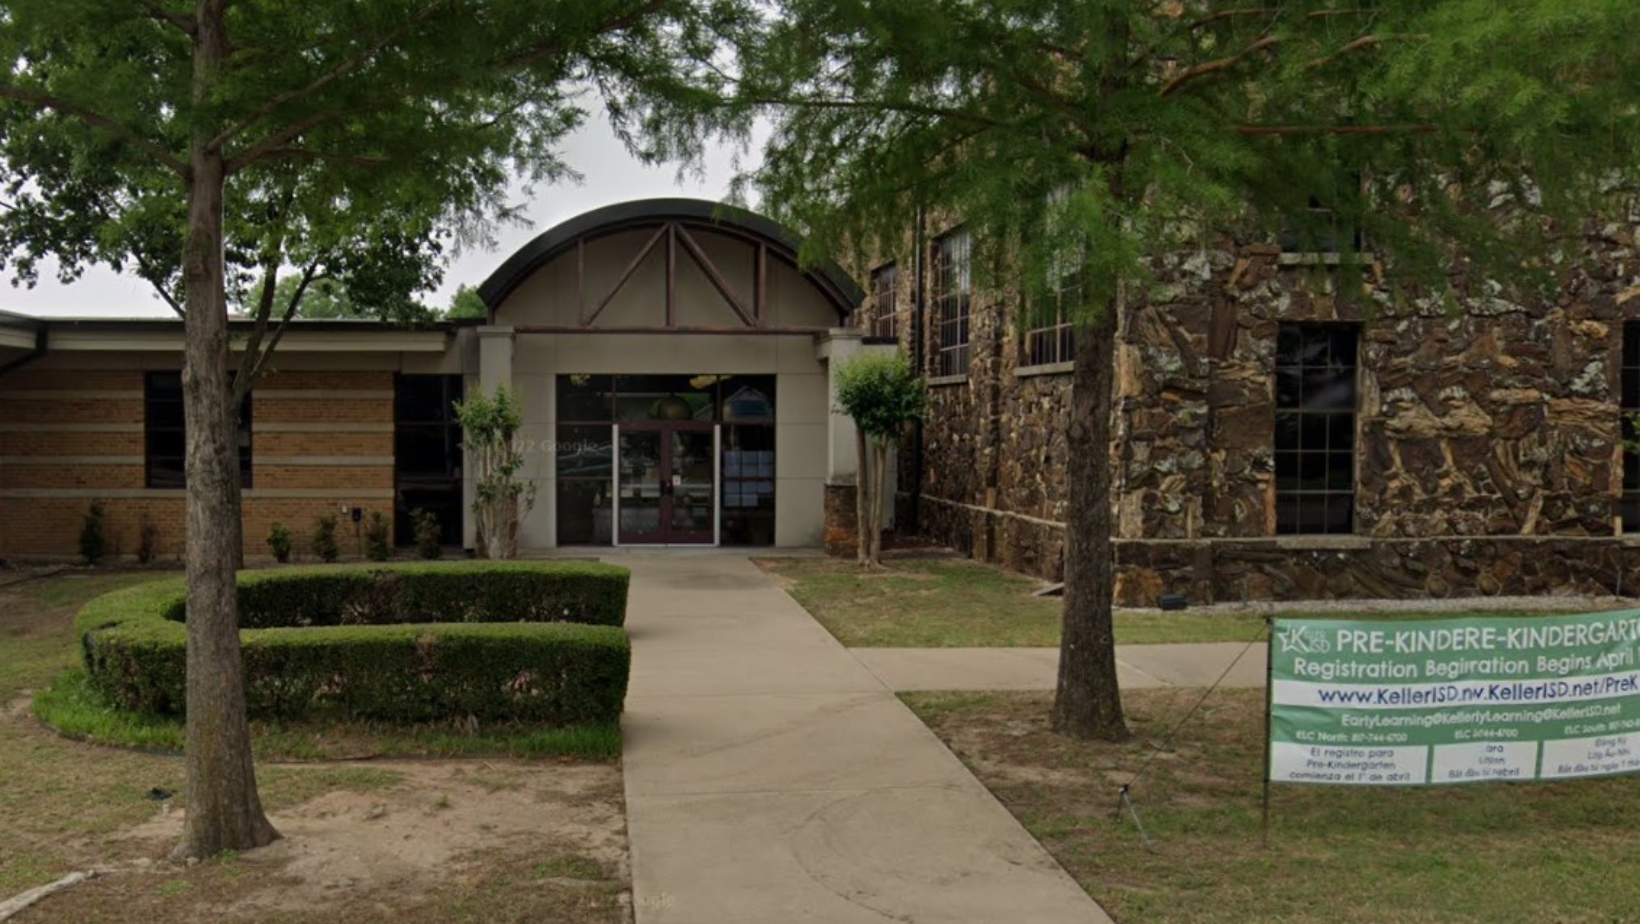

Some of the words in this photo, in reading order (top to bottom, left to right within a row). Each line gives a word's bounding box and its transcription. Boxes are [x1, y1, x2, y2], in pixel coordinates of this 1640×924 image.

[1294, 657, 1418, 680] Registration
[1536, 653, 1592, 675] Begins
[1597, 647, 1634, 671] April
[1296, 730, 1315, 740] ELC
[1454, 729, 1470, 739] ELC
[1564, 725, 1580, 735] ELC
[1310, 747, 1320, 757] El
[1324, 748, 1365, 759] registro
[1368, 749, 1394, 759] para
[1306, 759, 1396, 771] Pre-Kindergarten
[1289, 771, 1342, 781] comienza
[1344, 771, 1354, 781] el
[1368, 772, 1383, 781] de
[1386, 772, 1411, 781] abril
